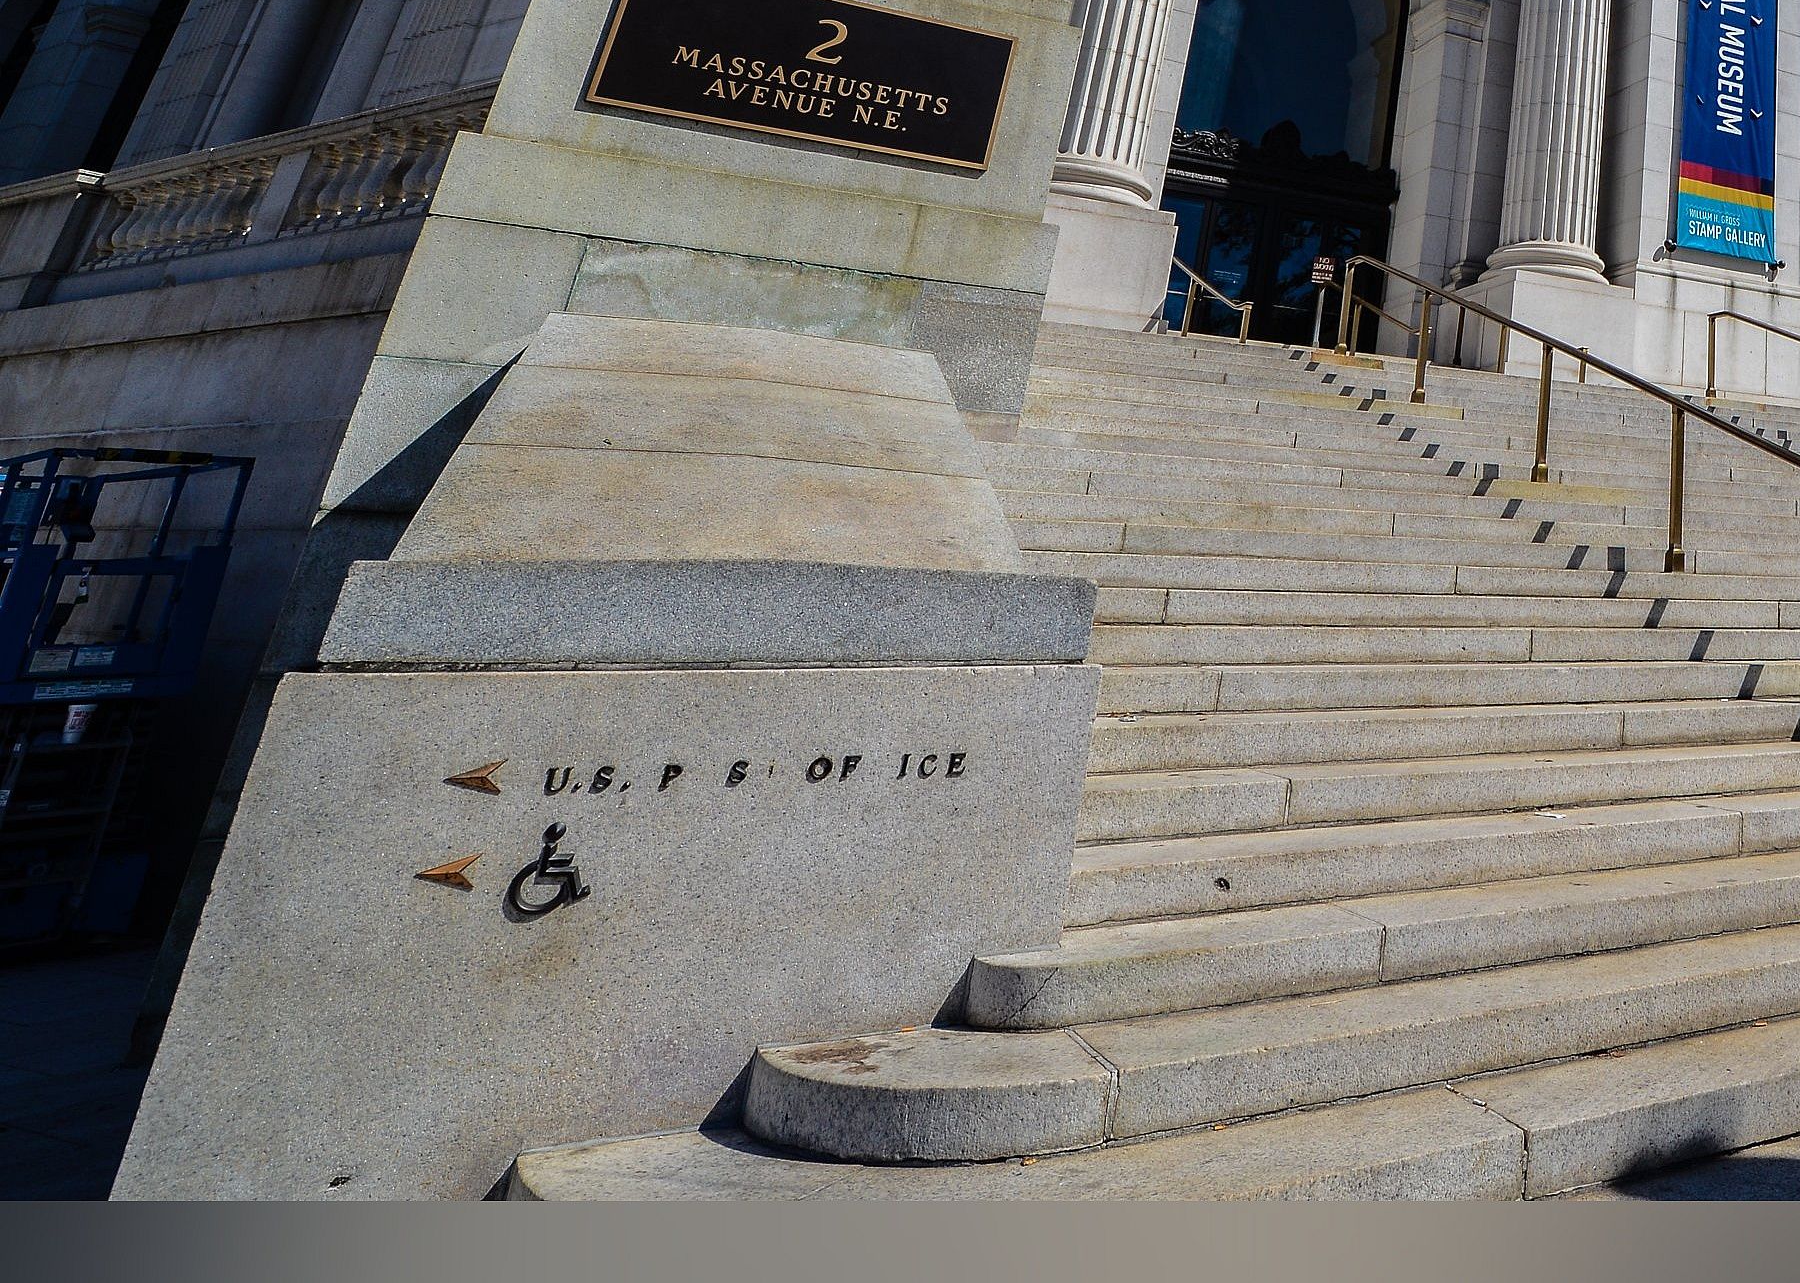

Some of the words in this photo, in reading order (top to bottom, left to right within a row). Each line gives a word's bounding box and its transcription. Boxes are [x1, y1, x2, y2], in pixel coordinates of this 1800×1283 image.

[805, 19, 849, 65] 2
[671, 46, 950, 116] MASSACHUSETTS
[1716, 22, 1746, 136] MUSEUM
[704, 79, 836, 117] AVENUE
[851, 104, 908, 133] N.E.
[1689, 220, 1722, 240] STAMP
[1725, 227, 1766, 248] GALLERY
[544, 765, 631, 796] U.S.
